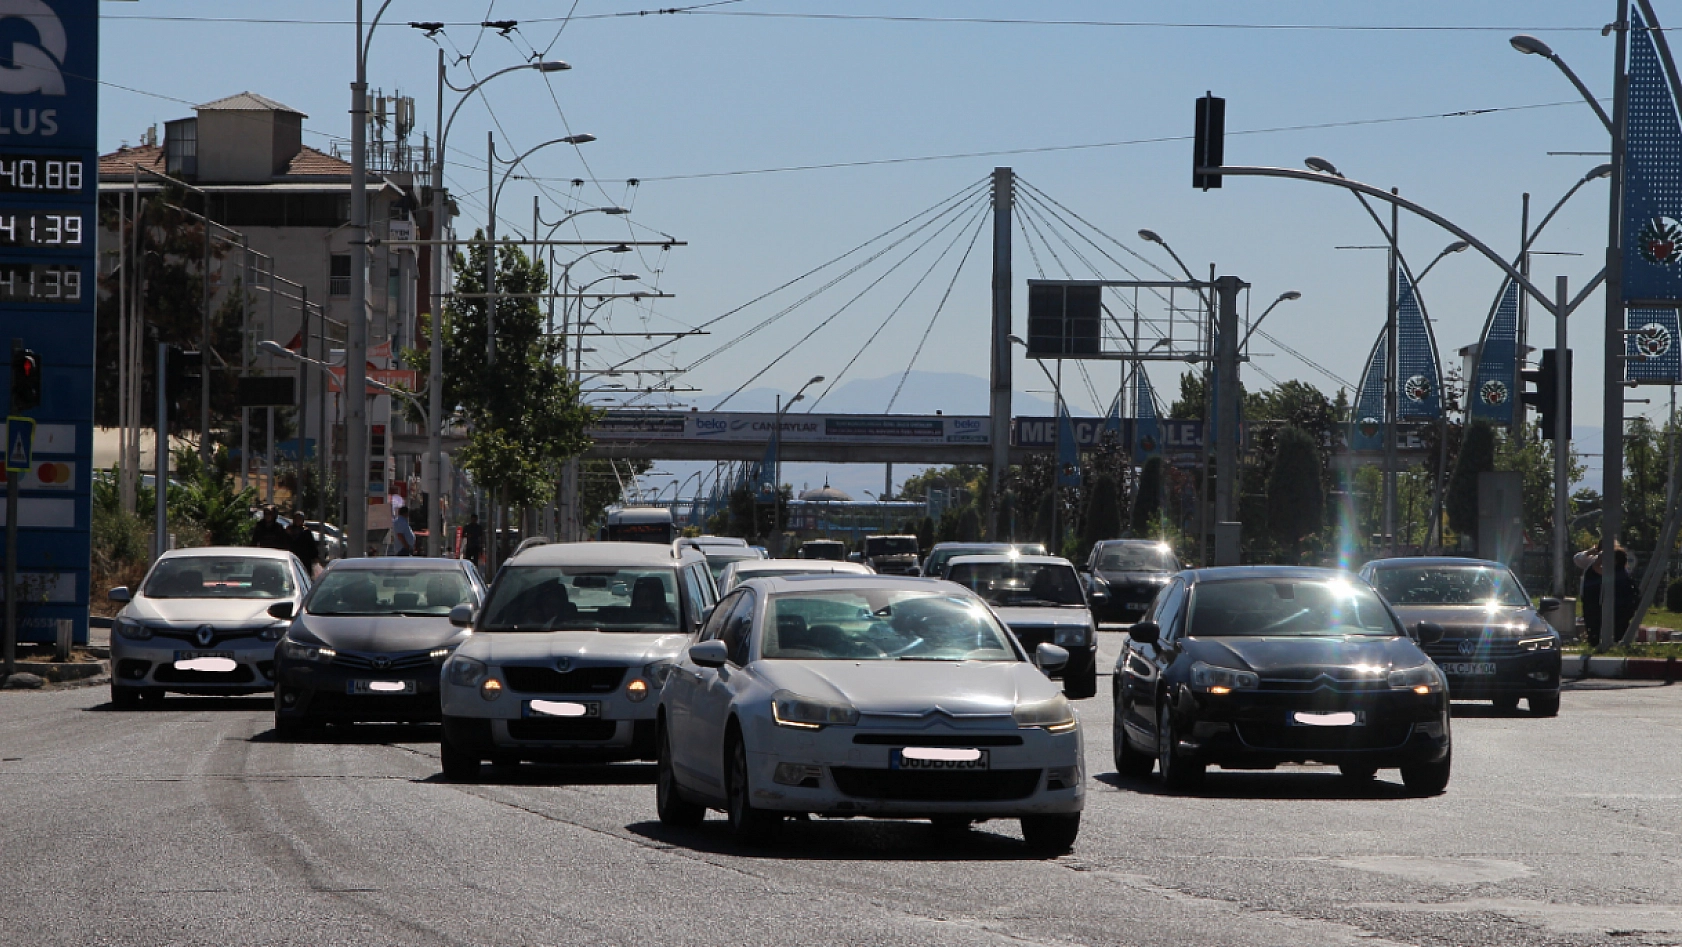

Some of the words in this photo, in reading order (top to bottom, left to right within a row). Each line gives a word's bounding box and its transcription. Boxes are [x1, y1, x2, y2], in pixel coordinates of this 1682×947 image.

[0, 160, 82, 189] 40.88
[0, 214, 82, 244] 41.39
[0, 269, 81, 298] 41.39
[695, 417, 727, 429] beko
